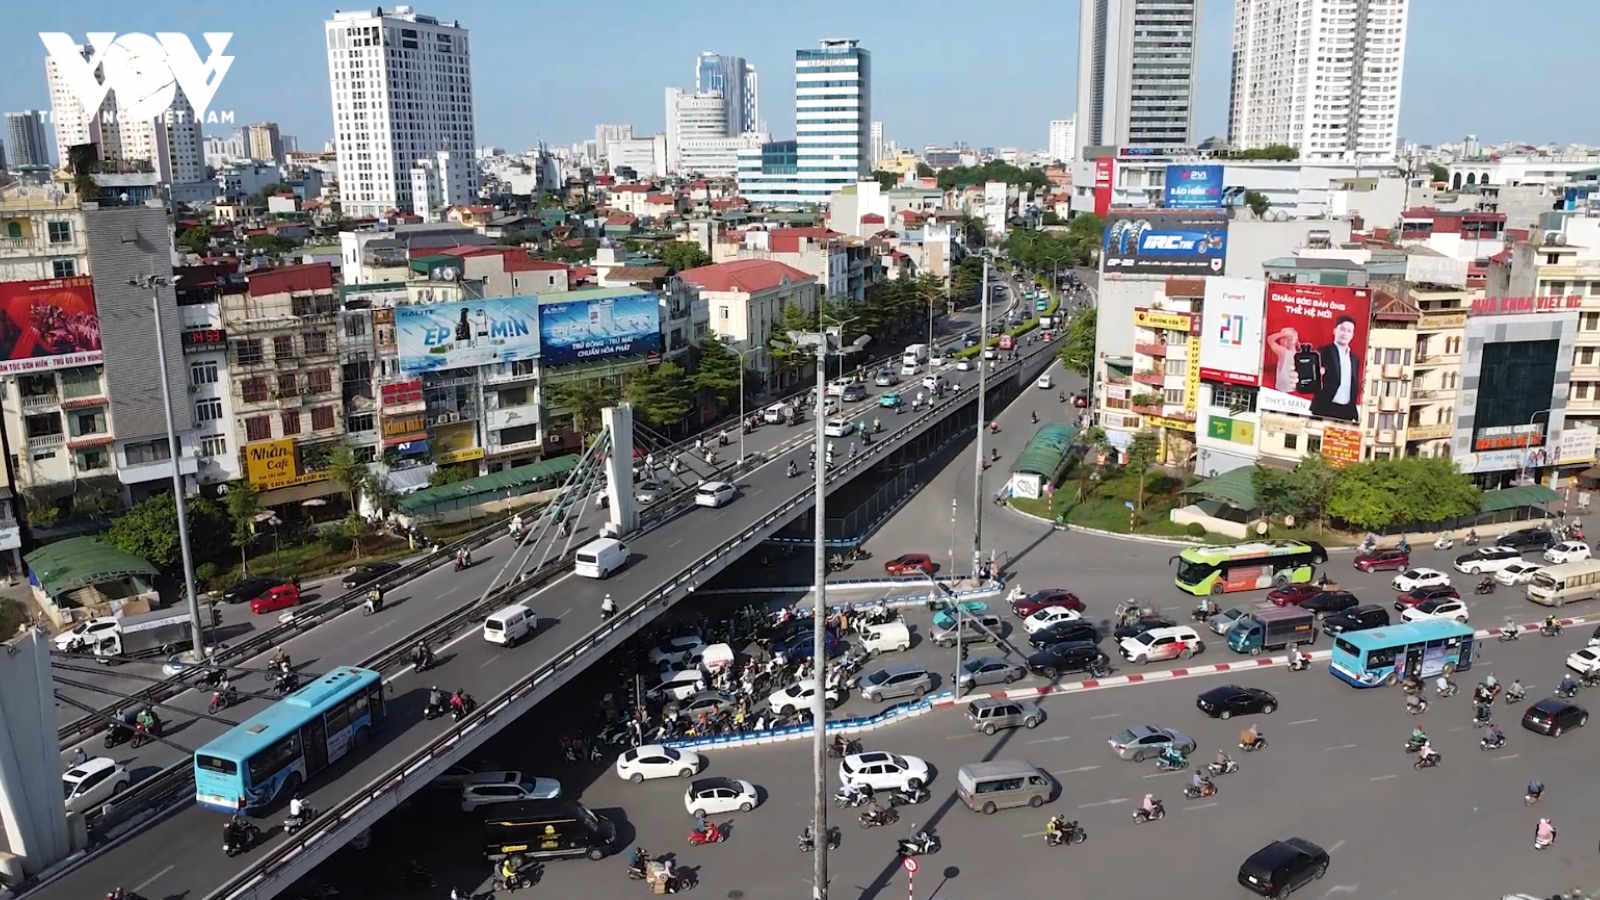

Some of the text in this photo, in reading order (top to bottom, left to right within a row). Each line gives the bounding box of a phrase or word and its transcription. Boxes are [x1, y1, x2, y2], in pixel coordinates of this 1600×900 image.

[1272, 293, 1295, 303] CHĂM
[402, 309, 436, 317] KALITE
[1317, 309, 1332, 319] MỚI
[1265, 396, 1307, 409] RHYS MAN
